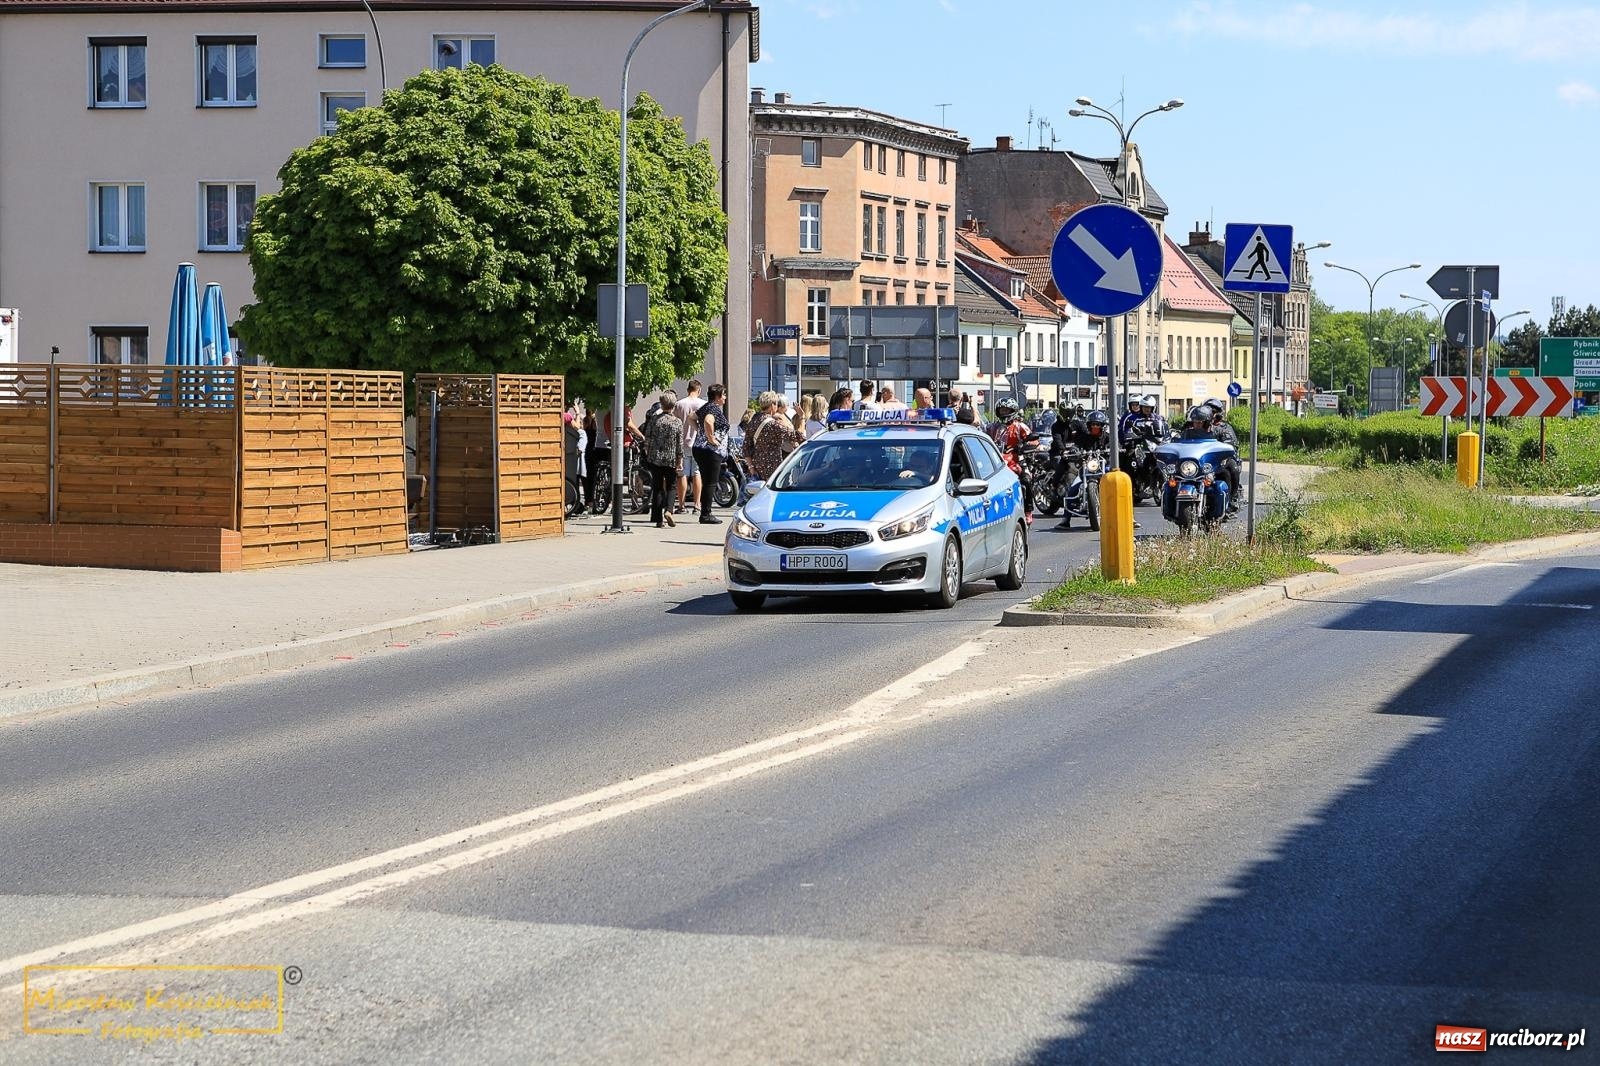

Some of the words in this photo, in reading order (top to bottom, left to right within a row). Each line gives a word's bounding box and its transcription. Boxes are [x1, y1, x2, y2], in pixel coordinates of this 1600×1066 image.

[1573, 340, 1600, 349] Rybnik
[863, 410, 902, 420] POLICJA
[788, 510, 856, 519] POLICJA
[788, 556, 810, 567] HPP
[814, 556, 844, 567] R006
